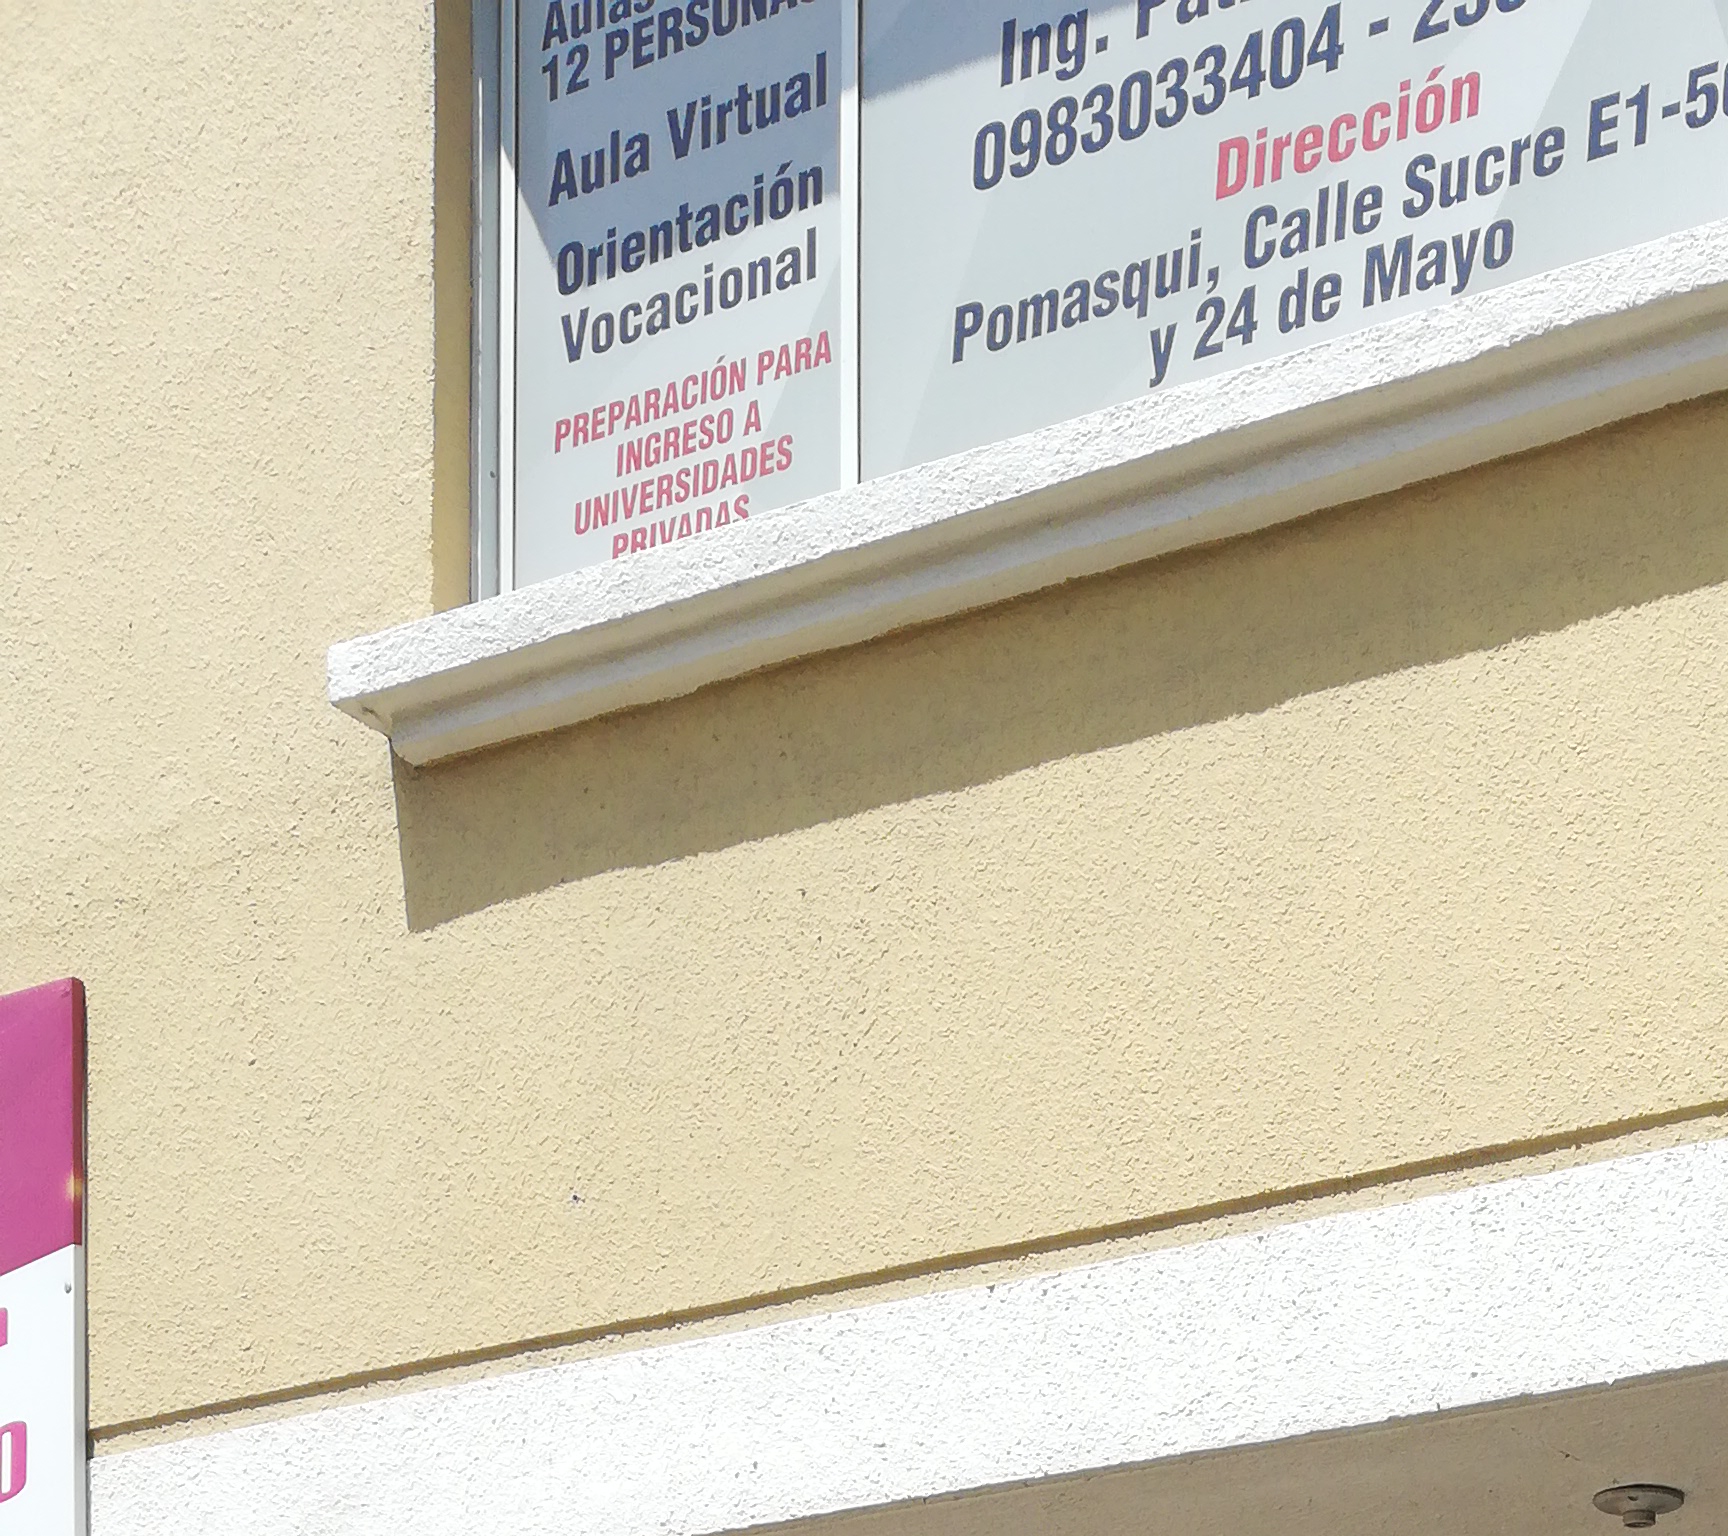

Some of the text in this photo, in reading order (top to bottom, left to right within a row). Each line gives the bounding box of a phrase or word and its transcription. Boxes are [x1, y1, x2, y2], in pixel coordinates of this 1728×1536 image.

[542, 0, 816, 101] 12 PERSON
[973, 2, 1345, 191] 0983033404
[1000, 8, 1109, 88] Ing.
[548, 50, 827, 207] Aula Virtual
[1215, 65, 1481, 200] Dirección
[557, 160, 823, 296] Orientación
[561, 227, 817, 363] Vocacional
[952, 227, 1220, 364] Pomasqui,
[1244, 179, 1383, 269] Calle
[1402, 125, 1565, 219] Sucre
[1149, 218, 1514, 388] y 24 de Mayo
[554, 330, 831, 454] PREPARACIÓN PARA
[616, 400, 761, 477] INGRESO A
[574, 434, 793, 535] UNIVERSIDADES
